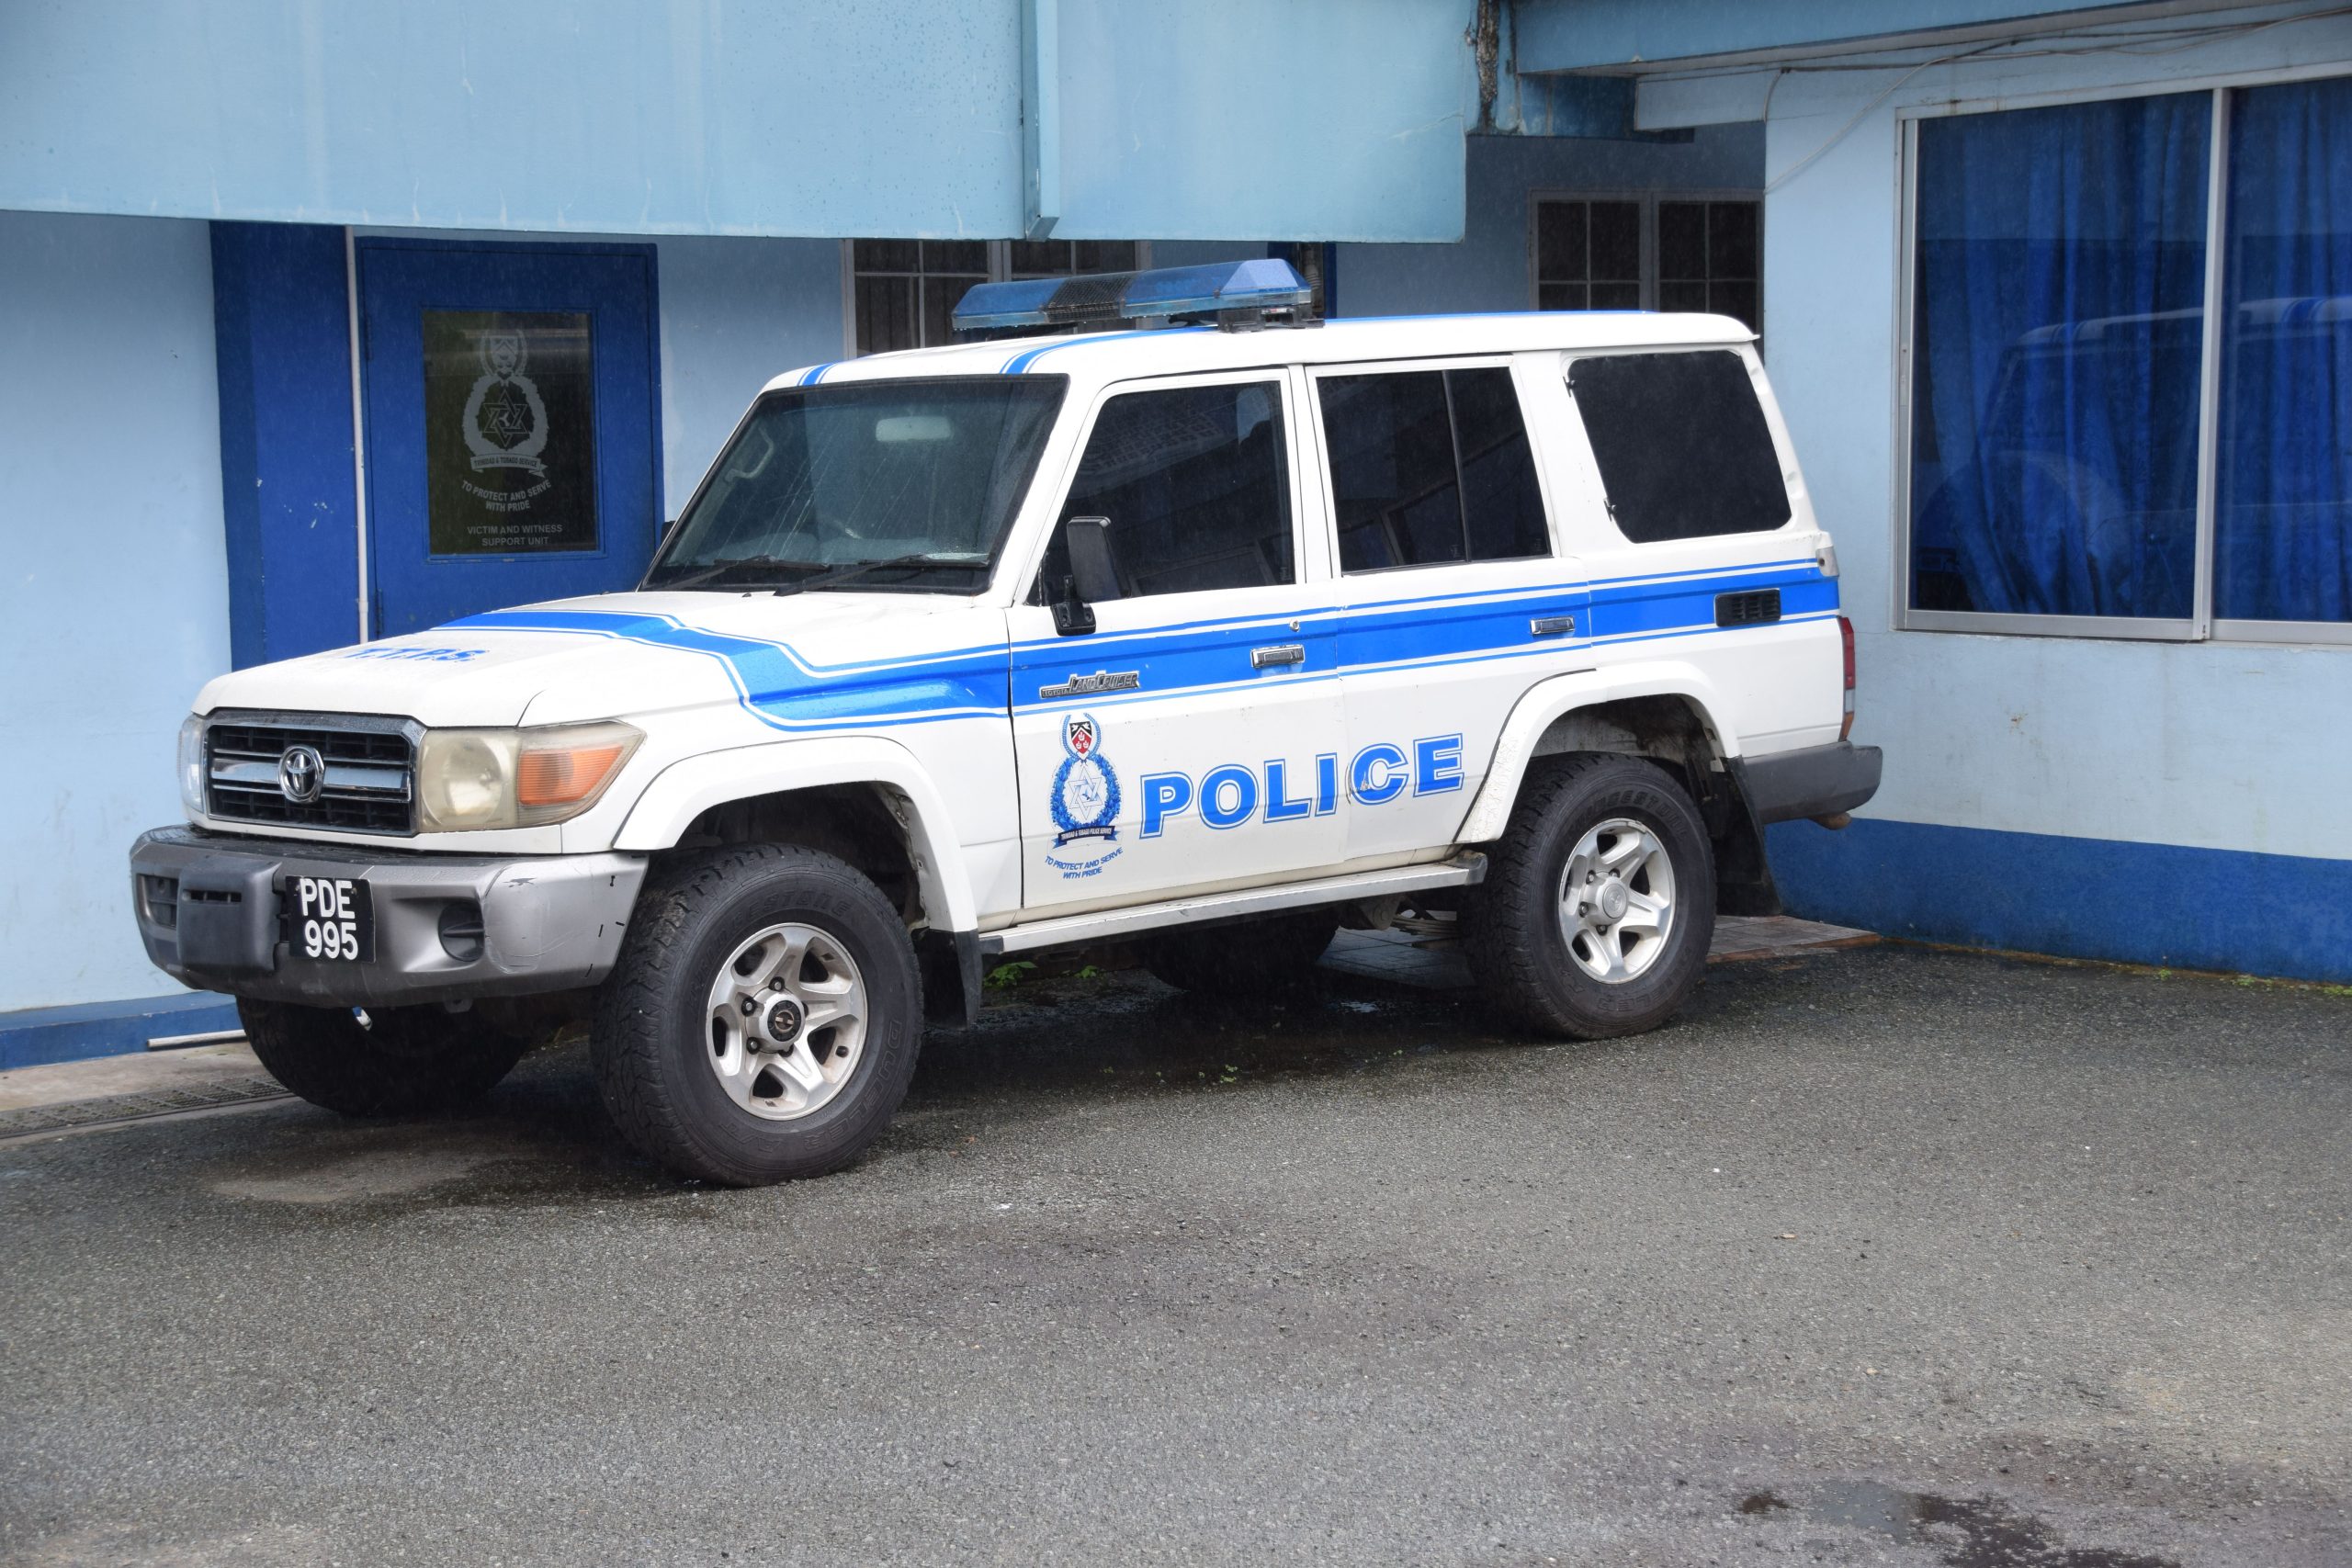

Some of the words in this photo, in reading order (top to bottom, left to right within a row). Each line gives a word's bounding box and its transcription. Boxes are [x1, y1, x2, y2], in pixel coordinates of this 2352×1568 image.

[461, 479, 472, 492] TO
[472, 487, 508, 502] PROTECT
[510, 491, 526, 501] AND
[527, 479, 551, 497] SERVE
[485, 501, 506, 512] WITH
[507, 500, 530, 512] PRIDE
[467, 525, 498, 535] VICTIM
[500, 525, 520, 534] AND
[521, 524, 563, 534] WITNESS
[481, 536, 526, 547] SUPPORT
[527, 536, 549, 546] UNIT
[1044, 688, 1069, 697] TOYOTA
[1139, 733, 1464, 840] POLICE
[1045, 856, 1054, 865] TO
[1053, 860, 1084, 871] PROTECT
[1084, 859, 1100, 869] AND
[1101, 847, 1124, 864] SERVE
[1062, 872, 1081, 880] WITH
[1081, 866, 1102, 878] PRIDE
[300, 878, 356, 919] PDE
[304, 919, 358, 961] 995
